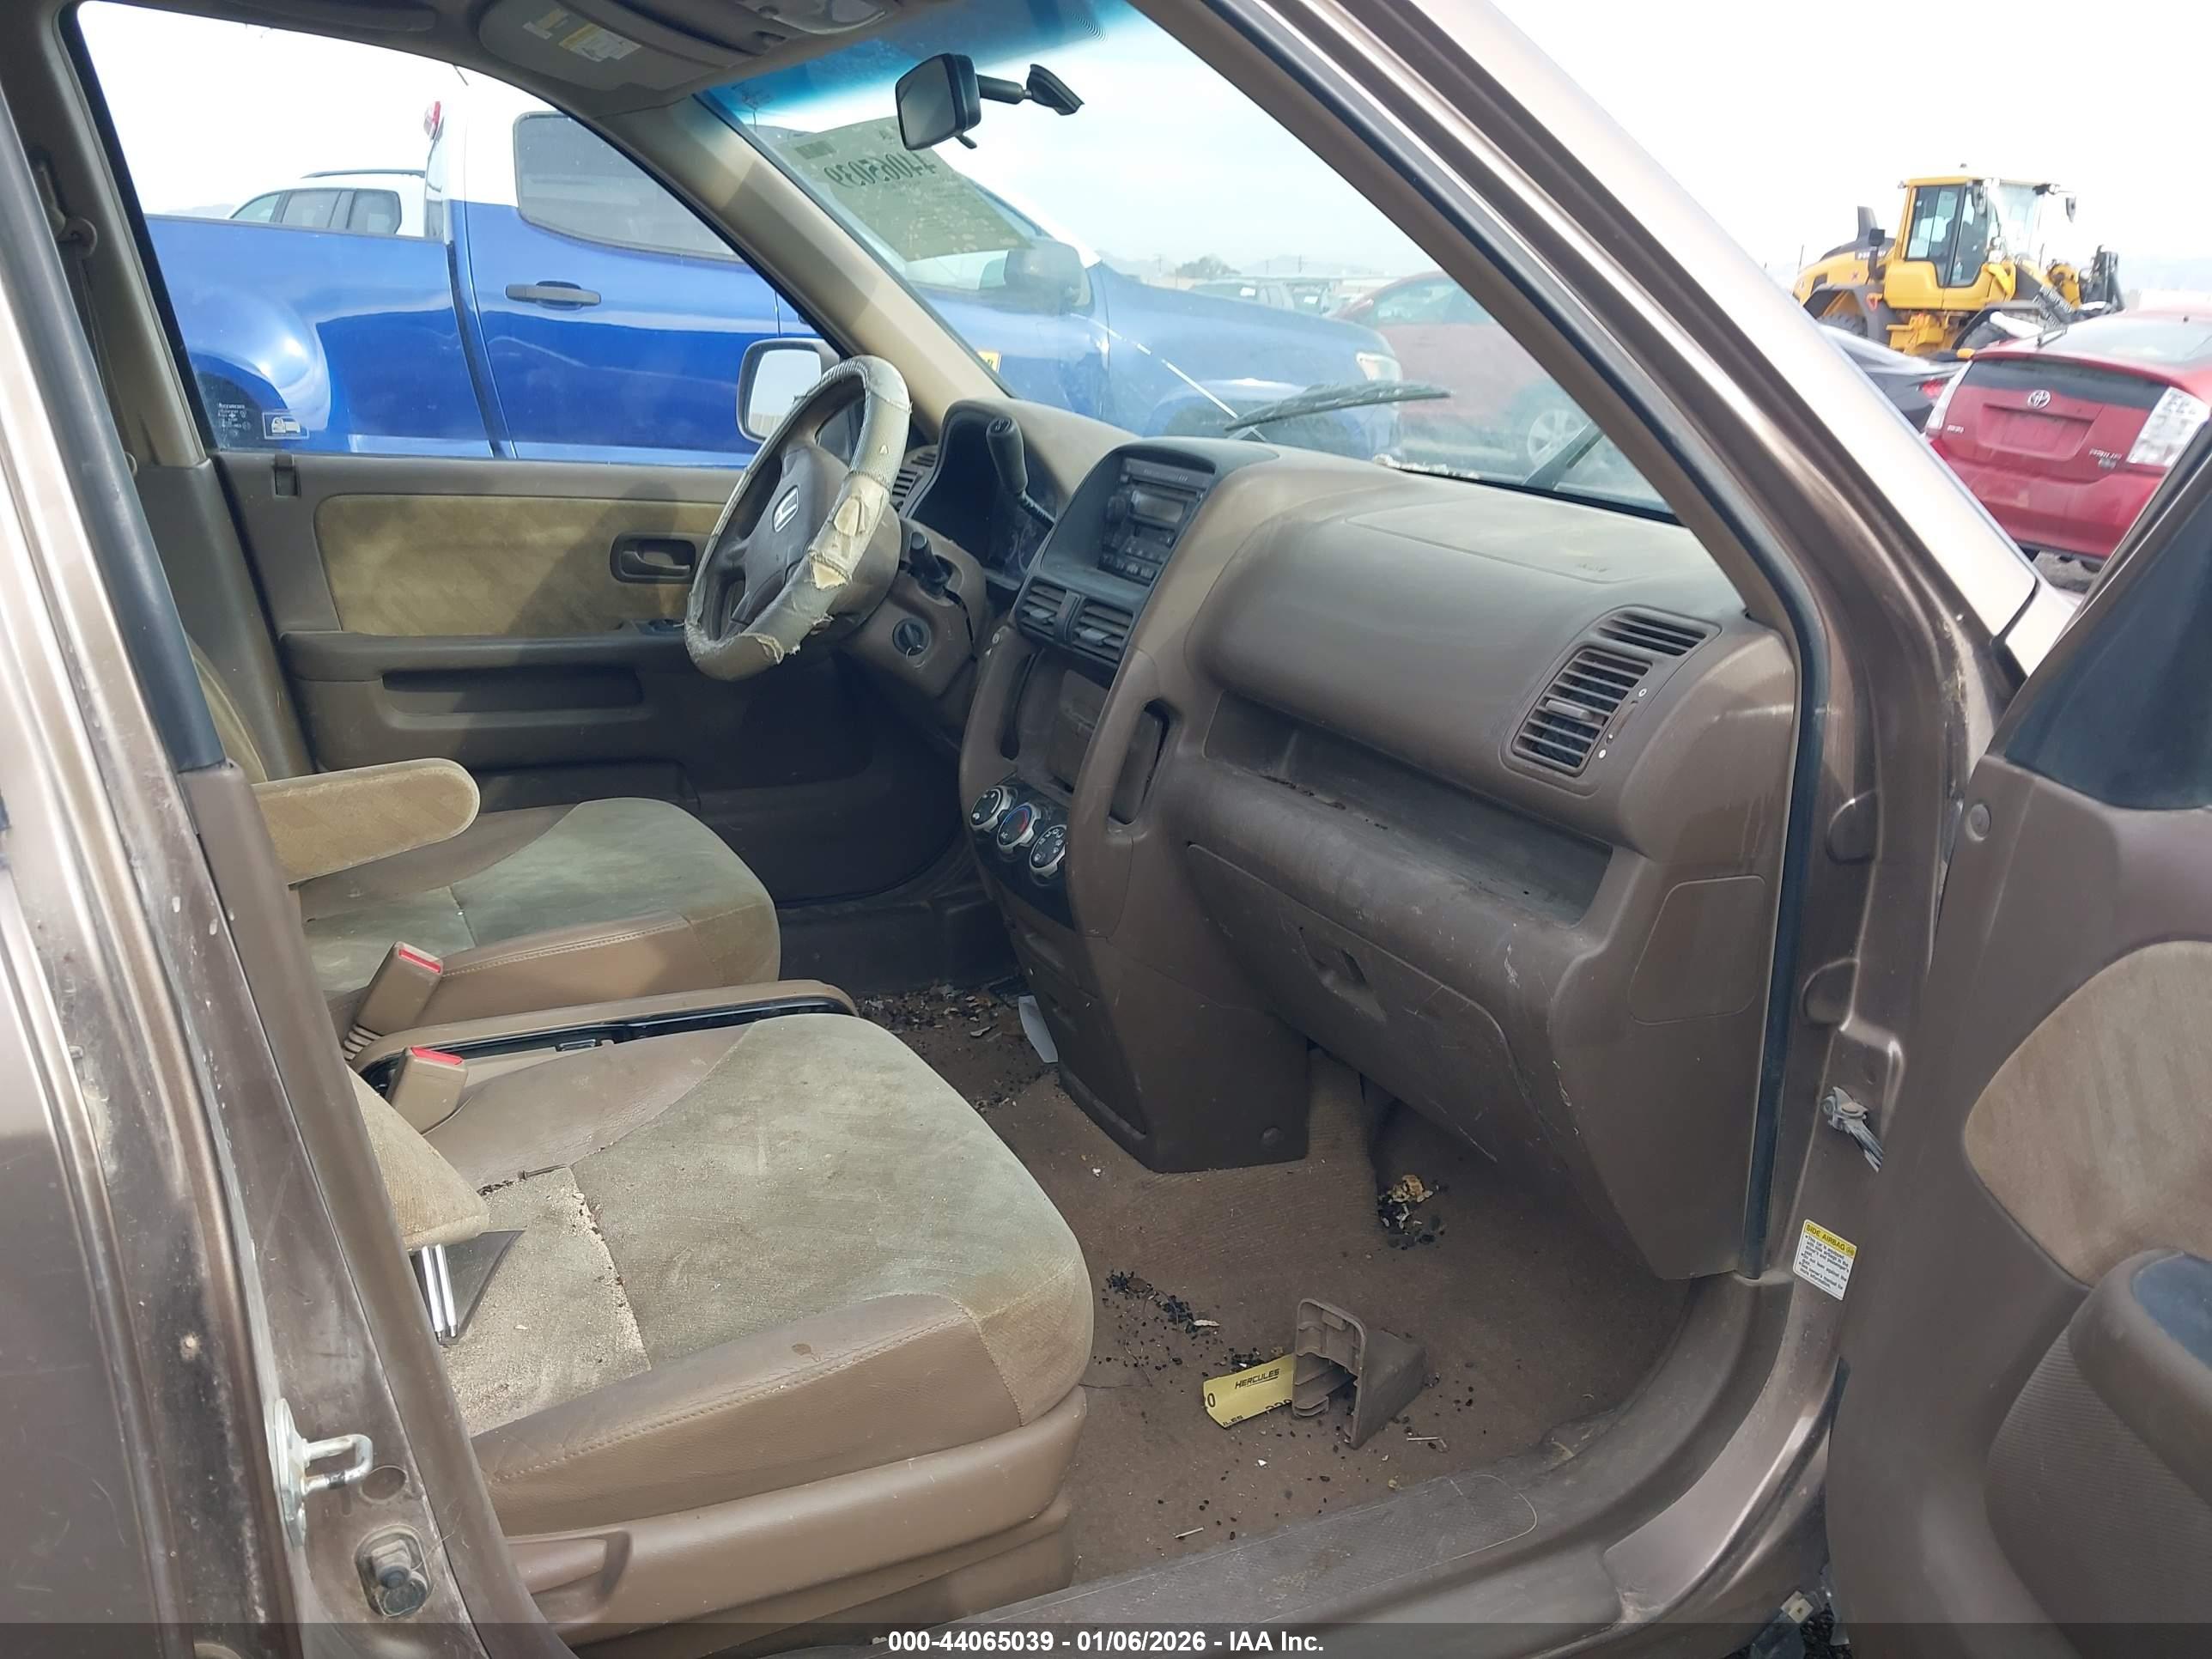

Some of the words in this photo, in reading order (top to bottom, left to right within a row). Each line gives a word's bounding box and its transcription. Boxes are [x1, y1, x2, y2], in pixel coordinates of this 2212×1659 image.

[1807, 1224, 1821, 1237] SIDE
[1822, 1234, 1845, 1250] AIRBAG
[1235, 1368, 1279, 1389] HERCULES
